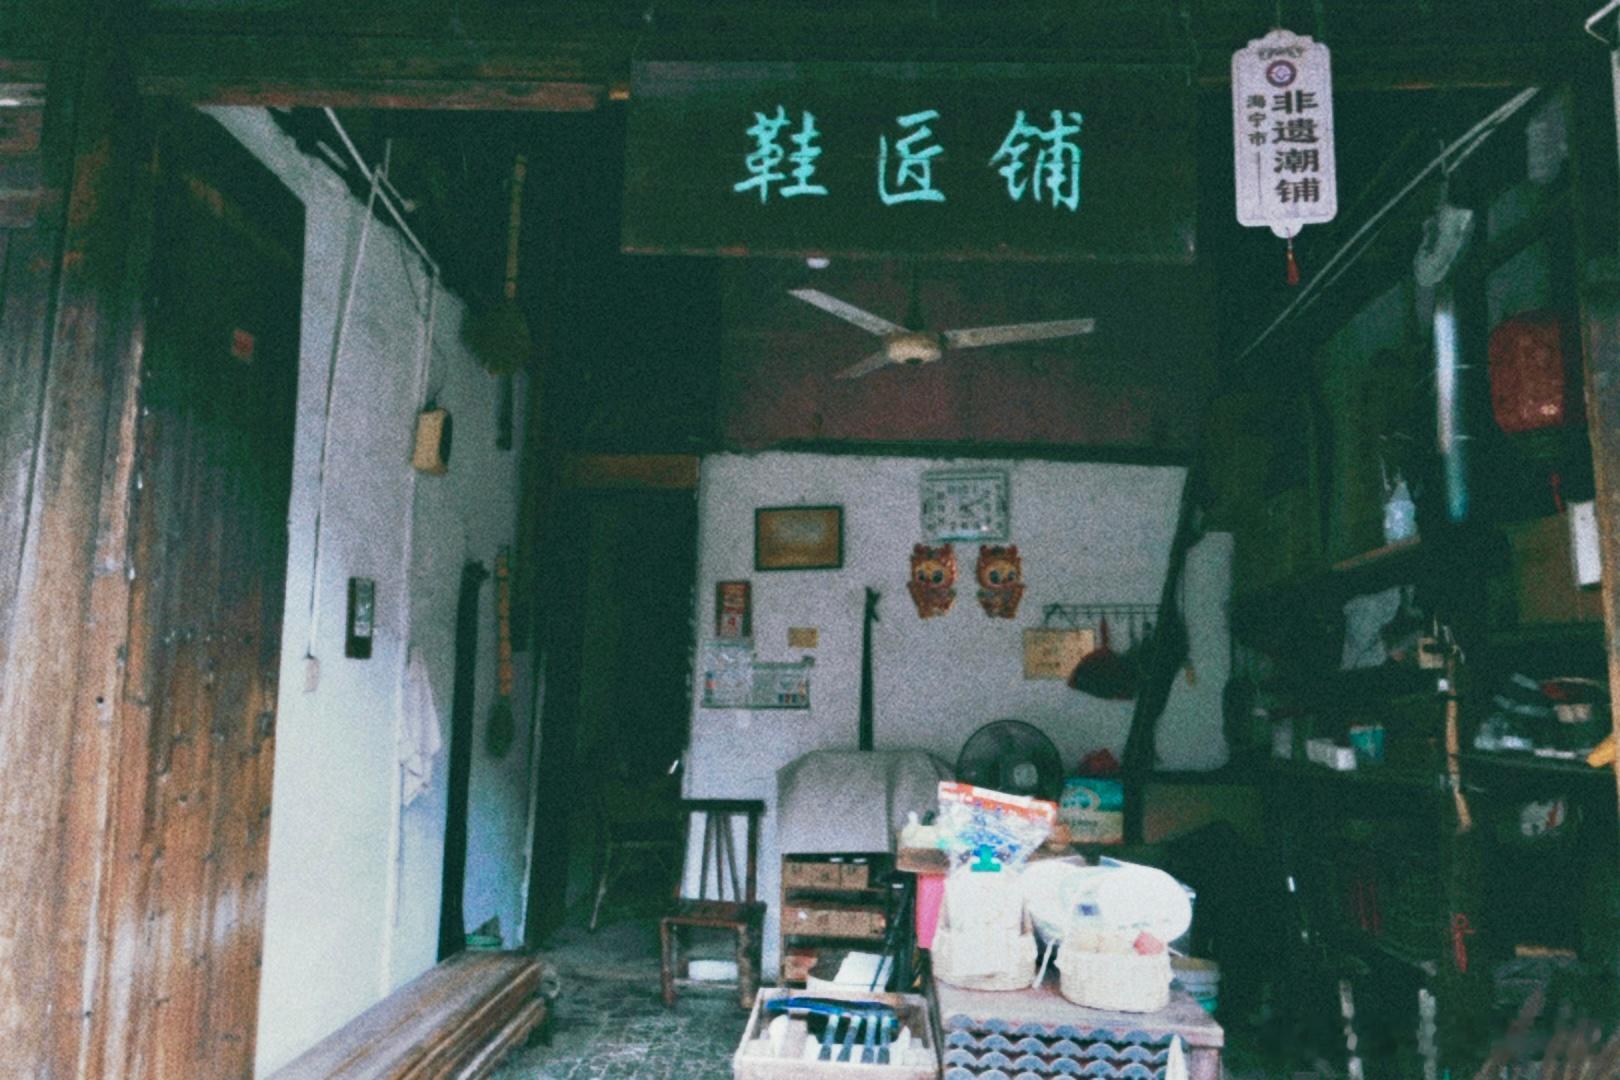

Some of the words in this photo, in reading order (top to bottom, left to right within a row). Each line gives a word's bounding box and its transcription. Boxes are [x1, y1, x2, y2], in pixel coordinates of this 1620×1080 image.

[734, 104, 1084, 212] 鞋匠铺
[1271, 89, 1322, 204] 非遗潮铺
